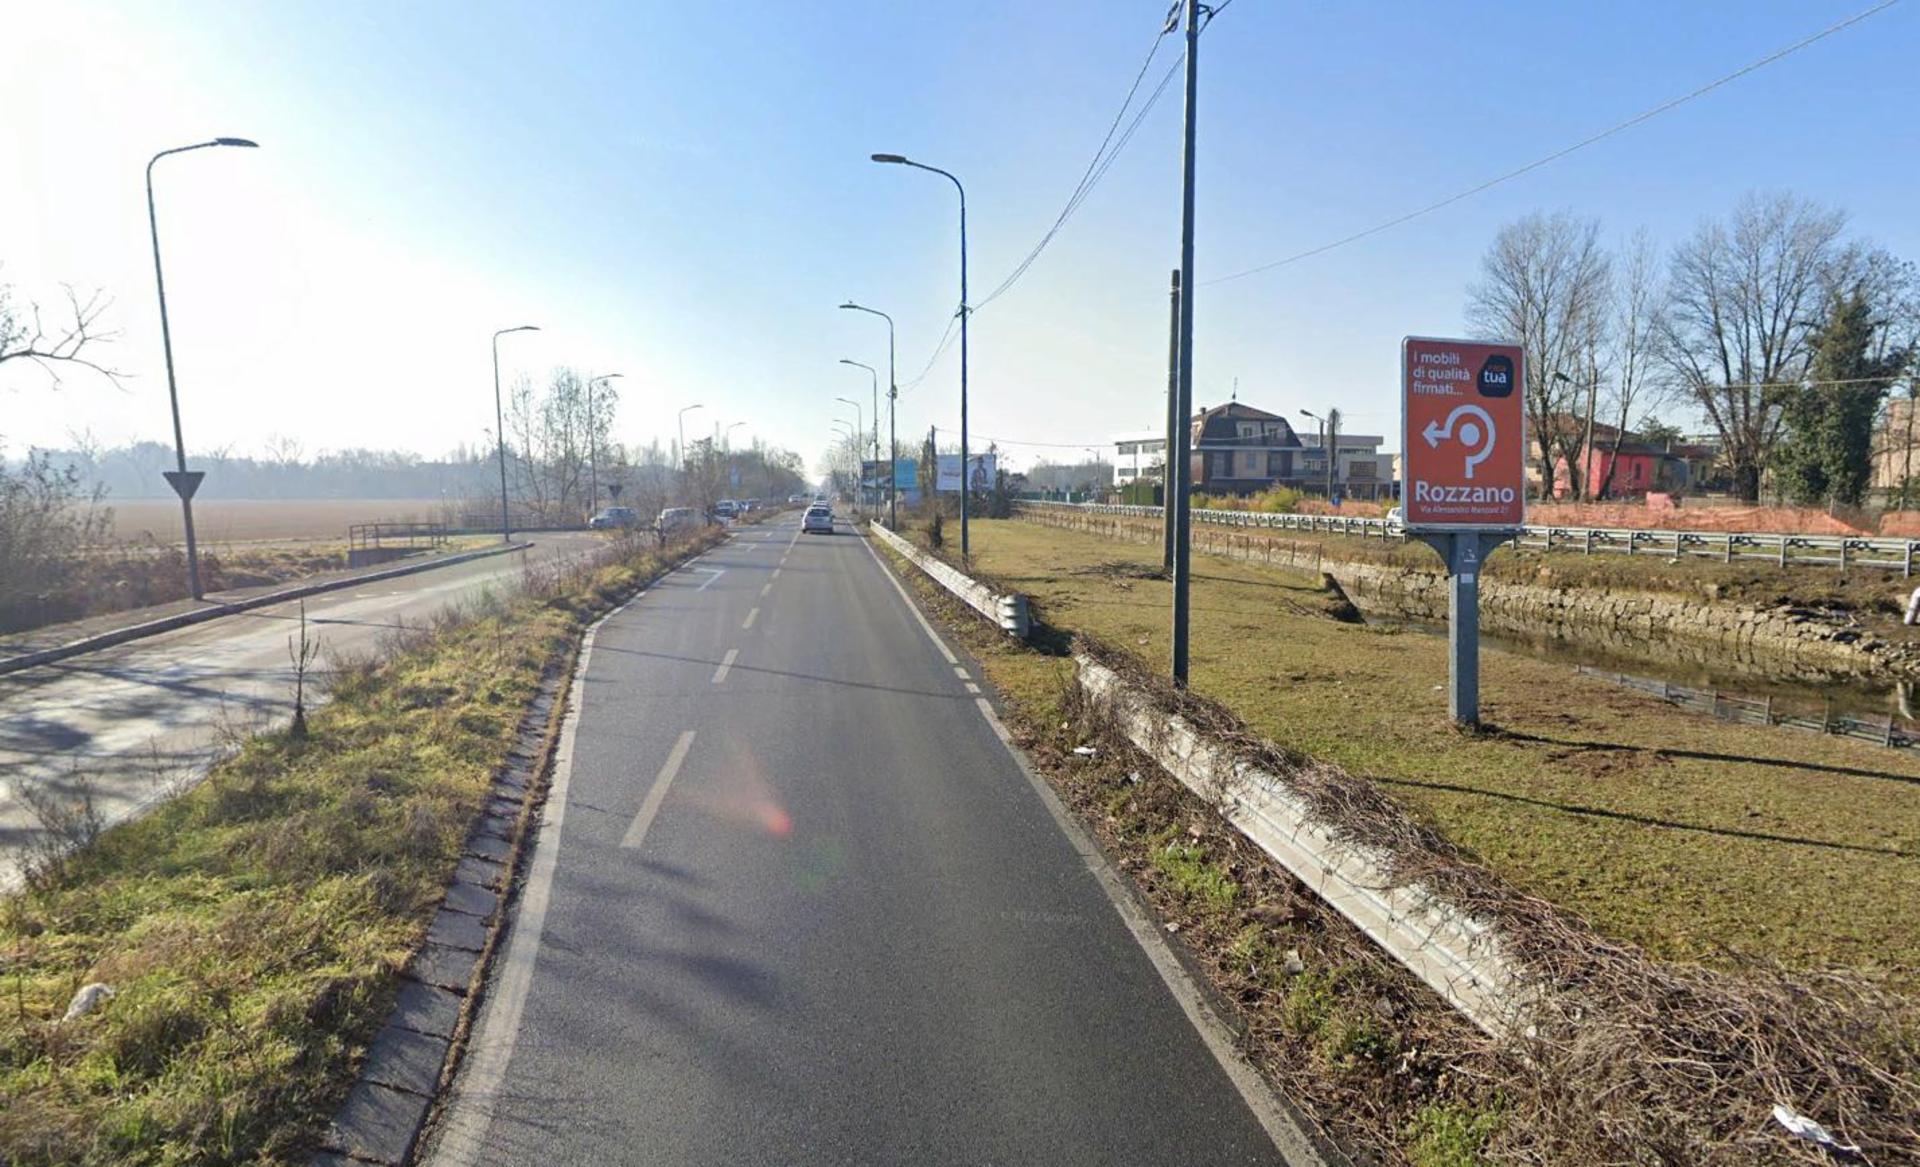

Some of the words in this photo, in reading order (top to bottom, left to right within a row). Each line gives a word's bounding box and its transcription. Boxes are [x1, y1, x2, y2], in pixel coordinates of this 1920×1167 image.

[1413, 350, 1417, 363] I
[1421, 352, 1460, 364] mobili
[1413, 365, 1425, 378] di
[1429, 367, 1470, 381] qualità
[1484, 371, 1507, 384] tua
[1413, 382, 1463, 395] firmati...
[1416, 481, 1514, 503] Rozzano
[1420, 505, 1431, 513] Via
